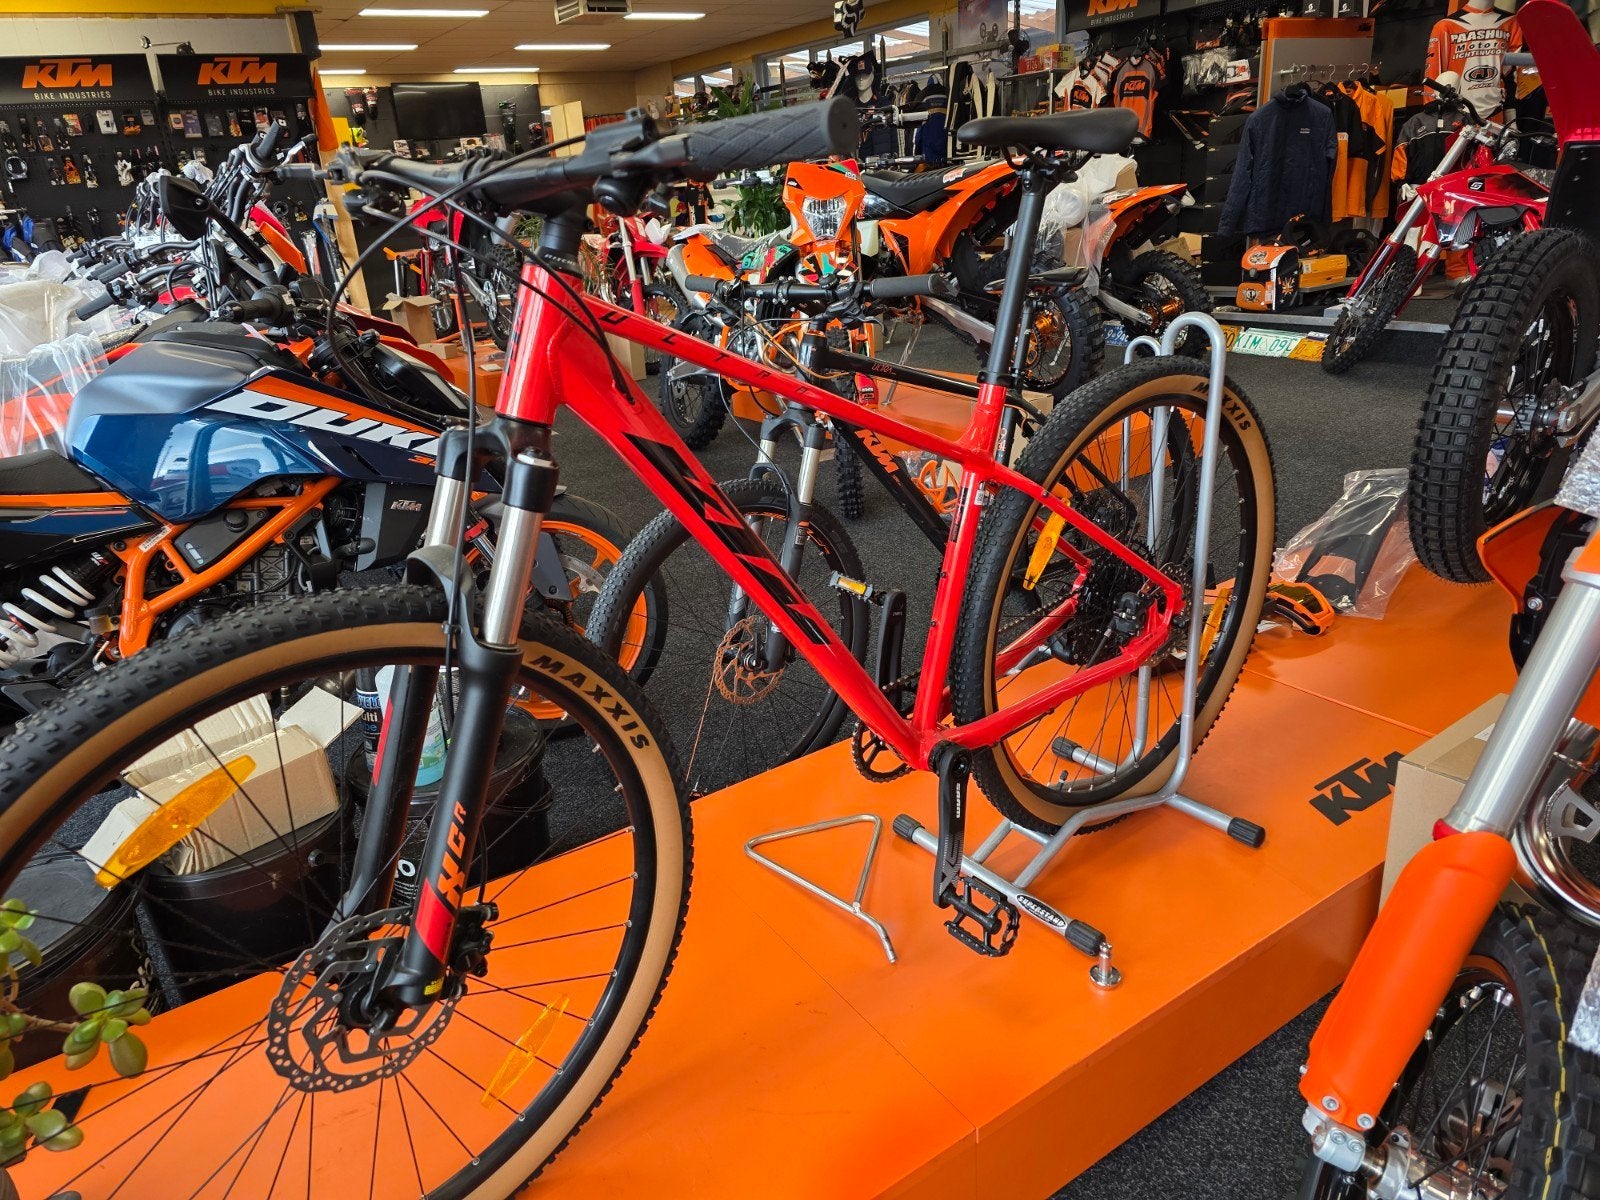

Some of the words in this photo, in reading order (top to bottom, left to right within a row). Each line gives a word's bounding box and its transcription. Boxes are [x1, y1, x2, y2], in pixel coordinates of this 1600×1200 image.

[1087, 0, 1138, 17] KTM
[1090, 18, 1103, 26] BIKE
[1104, 11, 1135, 24] INDUSTRIES
[22, 58, 113, 88] KTM
[197, 57, 278, 85] KTM
[34, 92, 54, 100] BIKE
[60, 91, 111, 99] INDUSTRIES
[230, 87, 276, 95] INDUSTRIES
[1193, 382, 1251, 430] MXXIS
[854, 429, 900, 474] KTM
[390, 499, 422, 511] KTM
[529, 655, 650, 749] MAXXIS
[1019, 895, 1066, 927] SUPERSTAND
